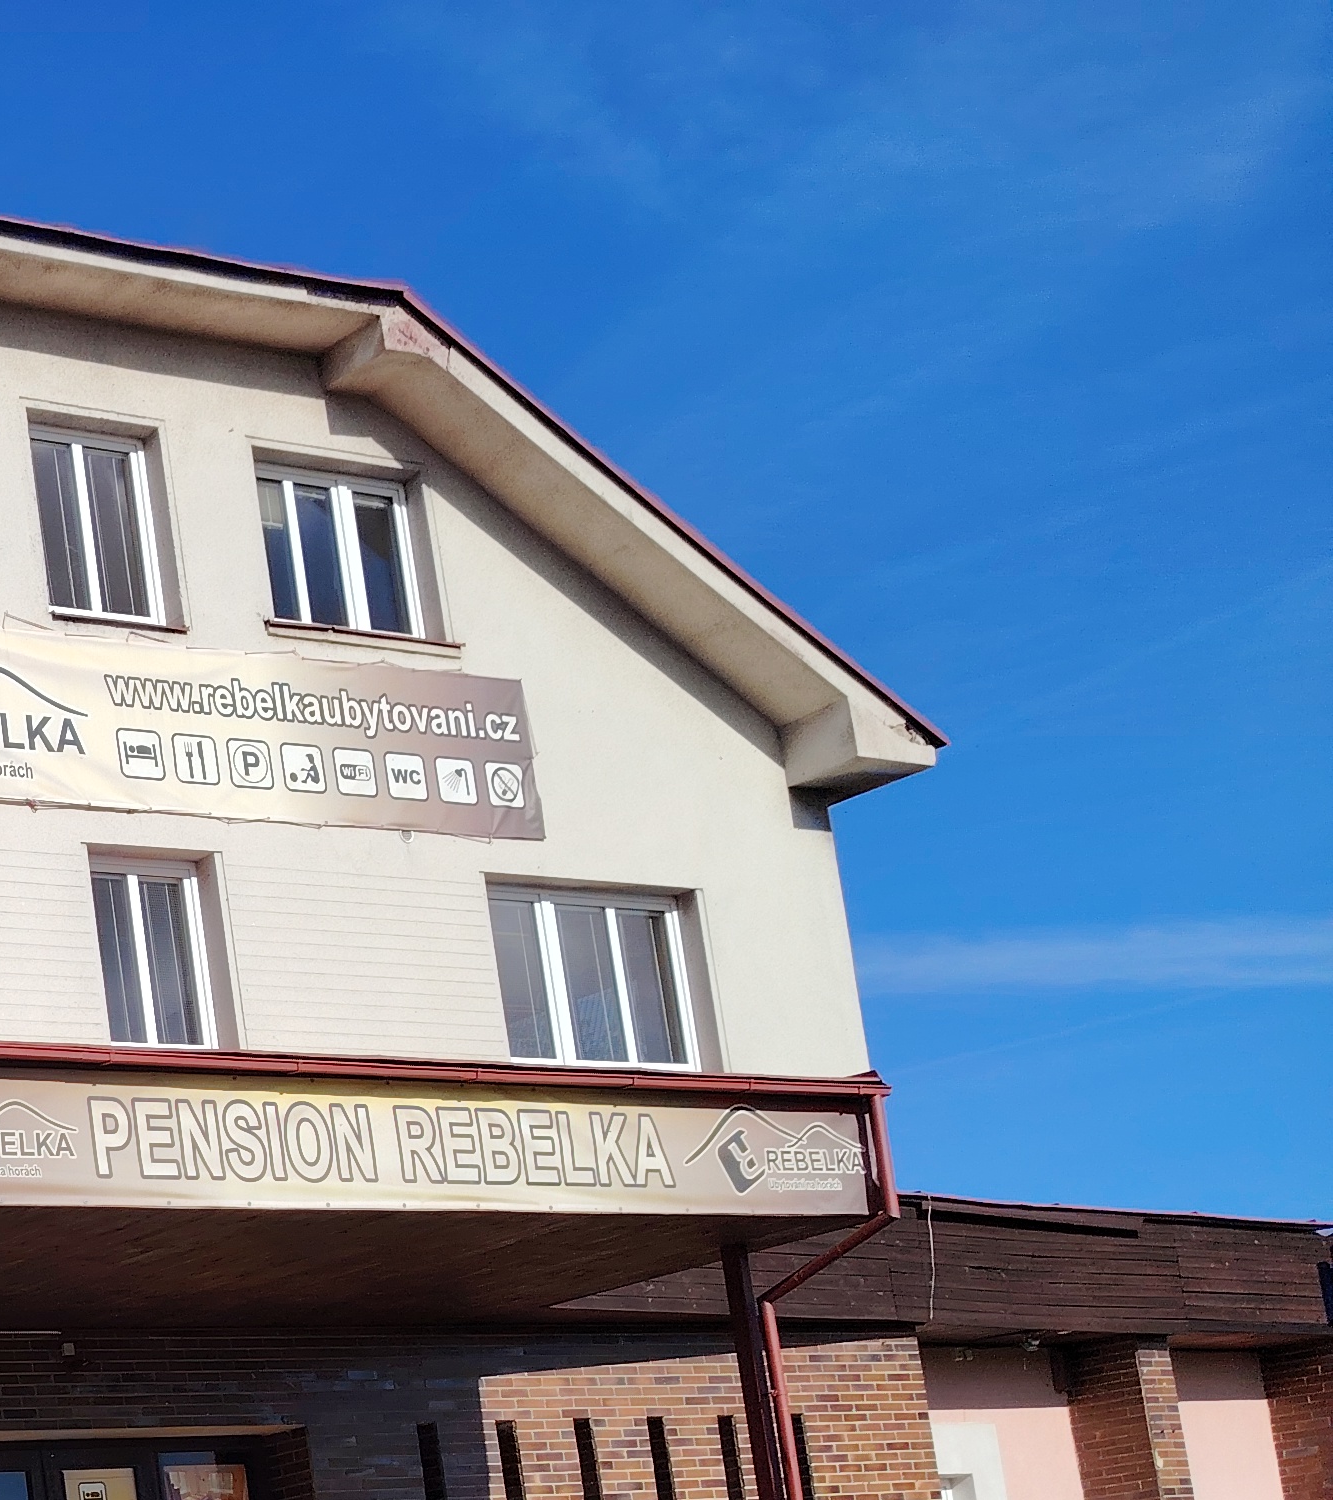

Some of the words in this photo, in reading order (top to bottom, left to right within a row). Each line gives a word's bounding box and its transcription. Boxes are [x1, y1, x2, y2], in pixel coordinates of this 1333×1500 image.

[104, 673, 521, 743] www.rebelkaubytovani.cz
[391, 766, 422, 786] WC
[87, 1095, 380, 1182] PENSION
[392, 1104, 677, 1188] REBELKA
[8, 1165, 42, 1177] horách
[765, 1149, 866, 1172] REBELKA
